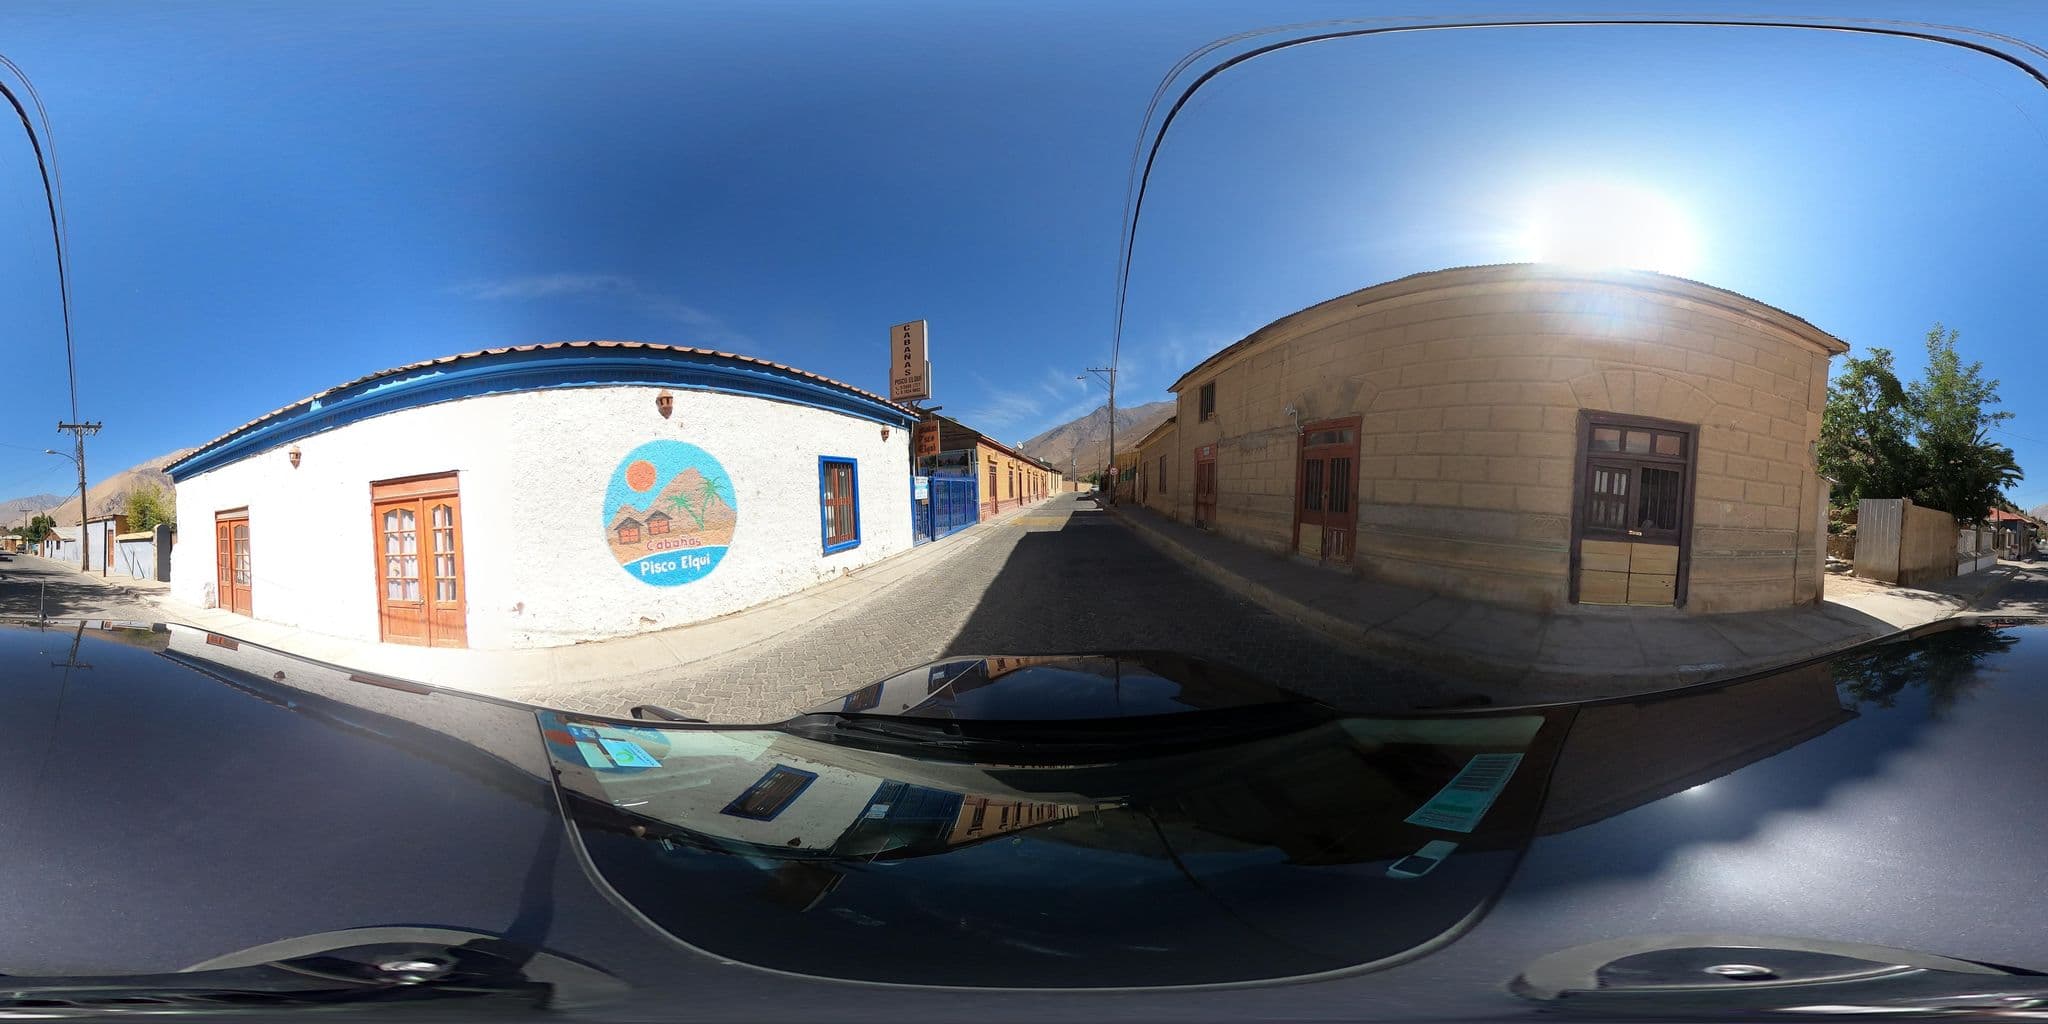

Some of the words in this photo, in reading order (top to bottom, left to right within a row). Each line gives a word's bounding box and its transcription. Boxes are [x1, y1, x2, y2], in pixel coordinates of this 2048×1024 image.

[646, 535, 702, 551] Cabañas
[640, 561, 677, 576] Pisco
[680, 552, 711, 572] Elqui
